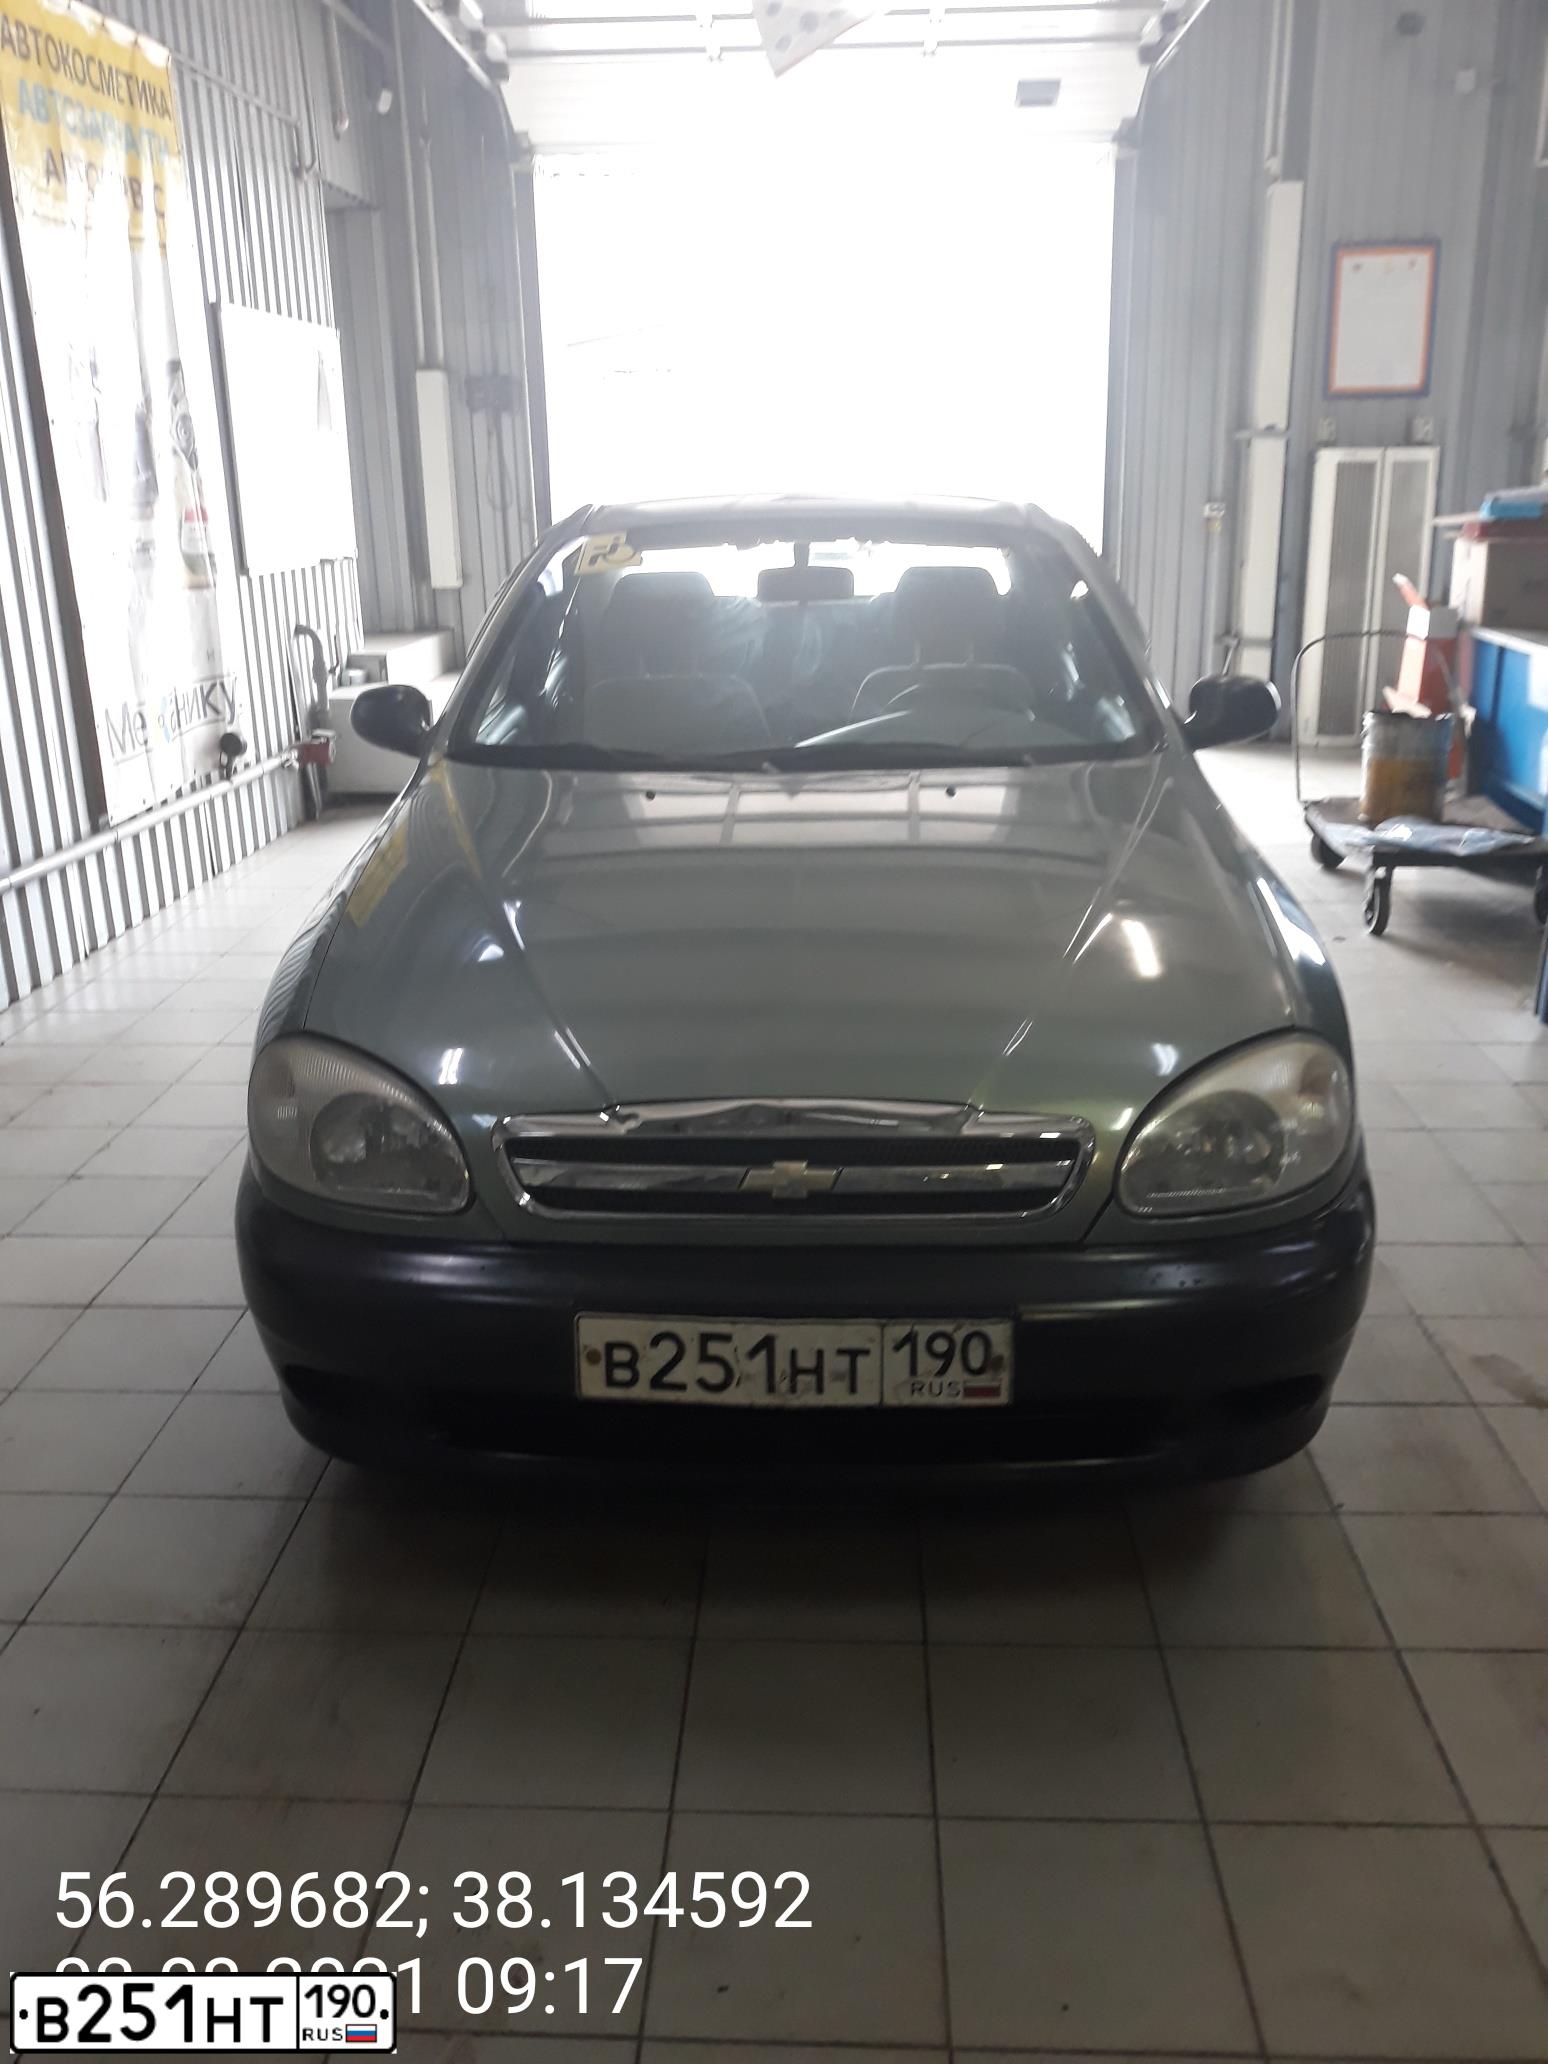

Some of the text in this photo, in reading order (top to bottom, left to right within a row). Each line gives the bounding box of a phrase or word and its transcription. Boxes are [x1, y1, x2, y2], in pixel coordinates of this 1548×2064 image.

[1, 14, 171, 120] АВТОКОСМЕТИКА
[604, 1324, 993, 1394] В251НТ 190
[910, 1380, 961, 1399] RUS
